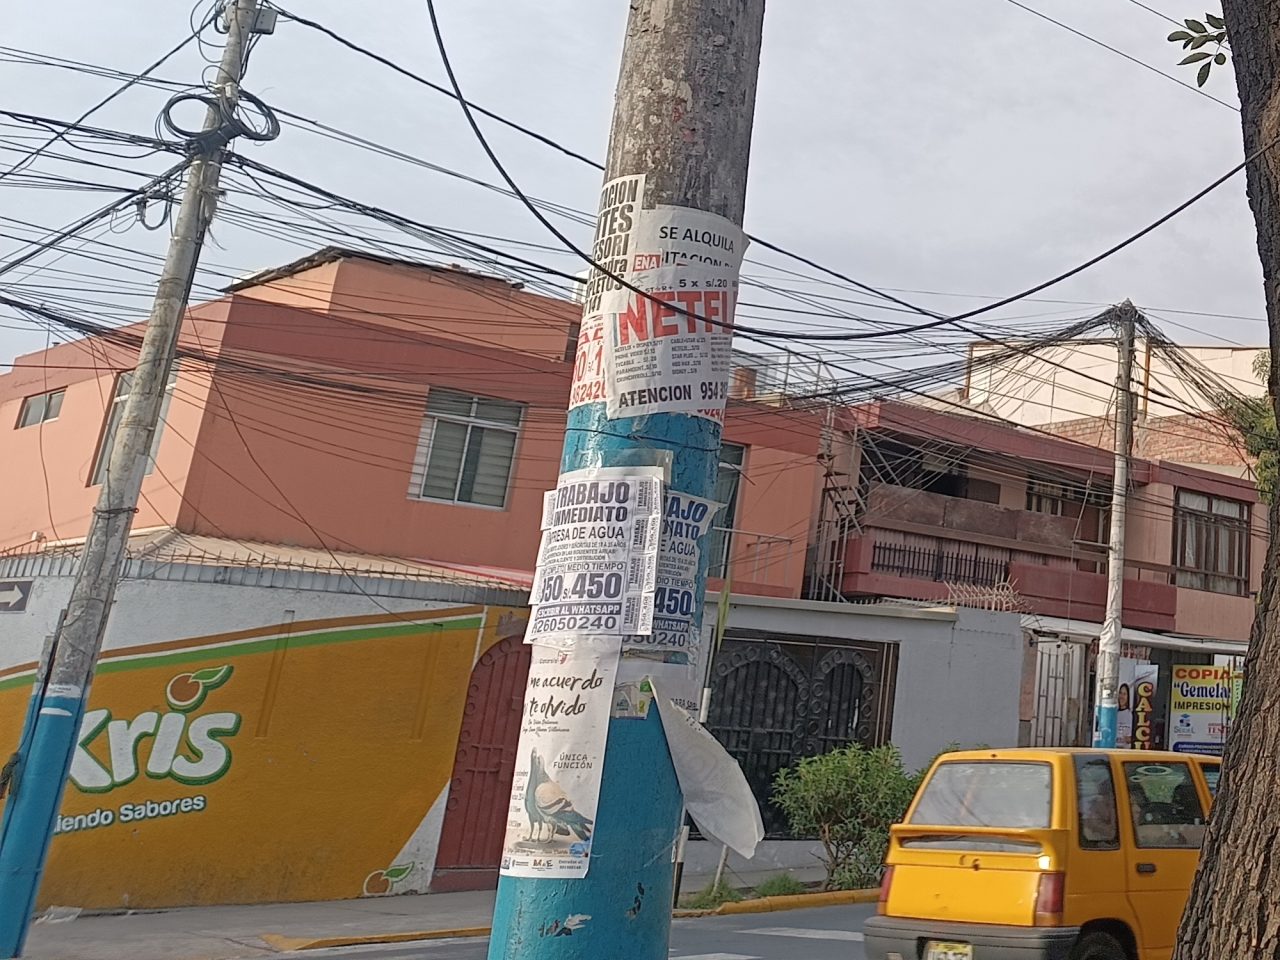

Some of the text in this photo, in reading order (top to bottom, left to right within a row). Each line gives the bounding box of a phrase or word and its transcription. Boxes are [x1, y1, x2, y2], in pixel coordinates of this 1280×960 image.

[596, 203, 634, 240] TES
[658, 225, 735, 254] SE ALQUILA
[678, 278, 687, 288] 5
[618, 384, 692, 409] ATENCION
[555, 481, 631, 510] TRABAJO
[553, 505, 628, 528] INMEDIATO
[664, 496, 709, 523] AJO
[572, 526, 587, 540] DE
[588, 525, 625, 540] AGUA
[669, 541, 696, 558] AGUA
[567, 562, 590, 571] MEDIO
[592, 561, 624, 571] TIEMPO
[671, 578, 694, 589] TIEMPO
[560, 605, 570, 615] AL
[571, 604, 621, 615] WHATSAPP
[542, 668, 604, 691] acuerdo
[529, 693, 587, 718] te olvido
[553, 761, 593, 769] FUNCIÓN
[559, 752, 588, 761] ÚNICA
[53, 794, 207, 836] iendo Sabores
